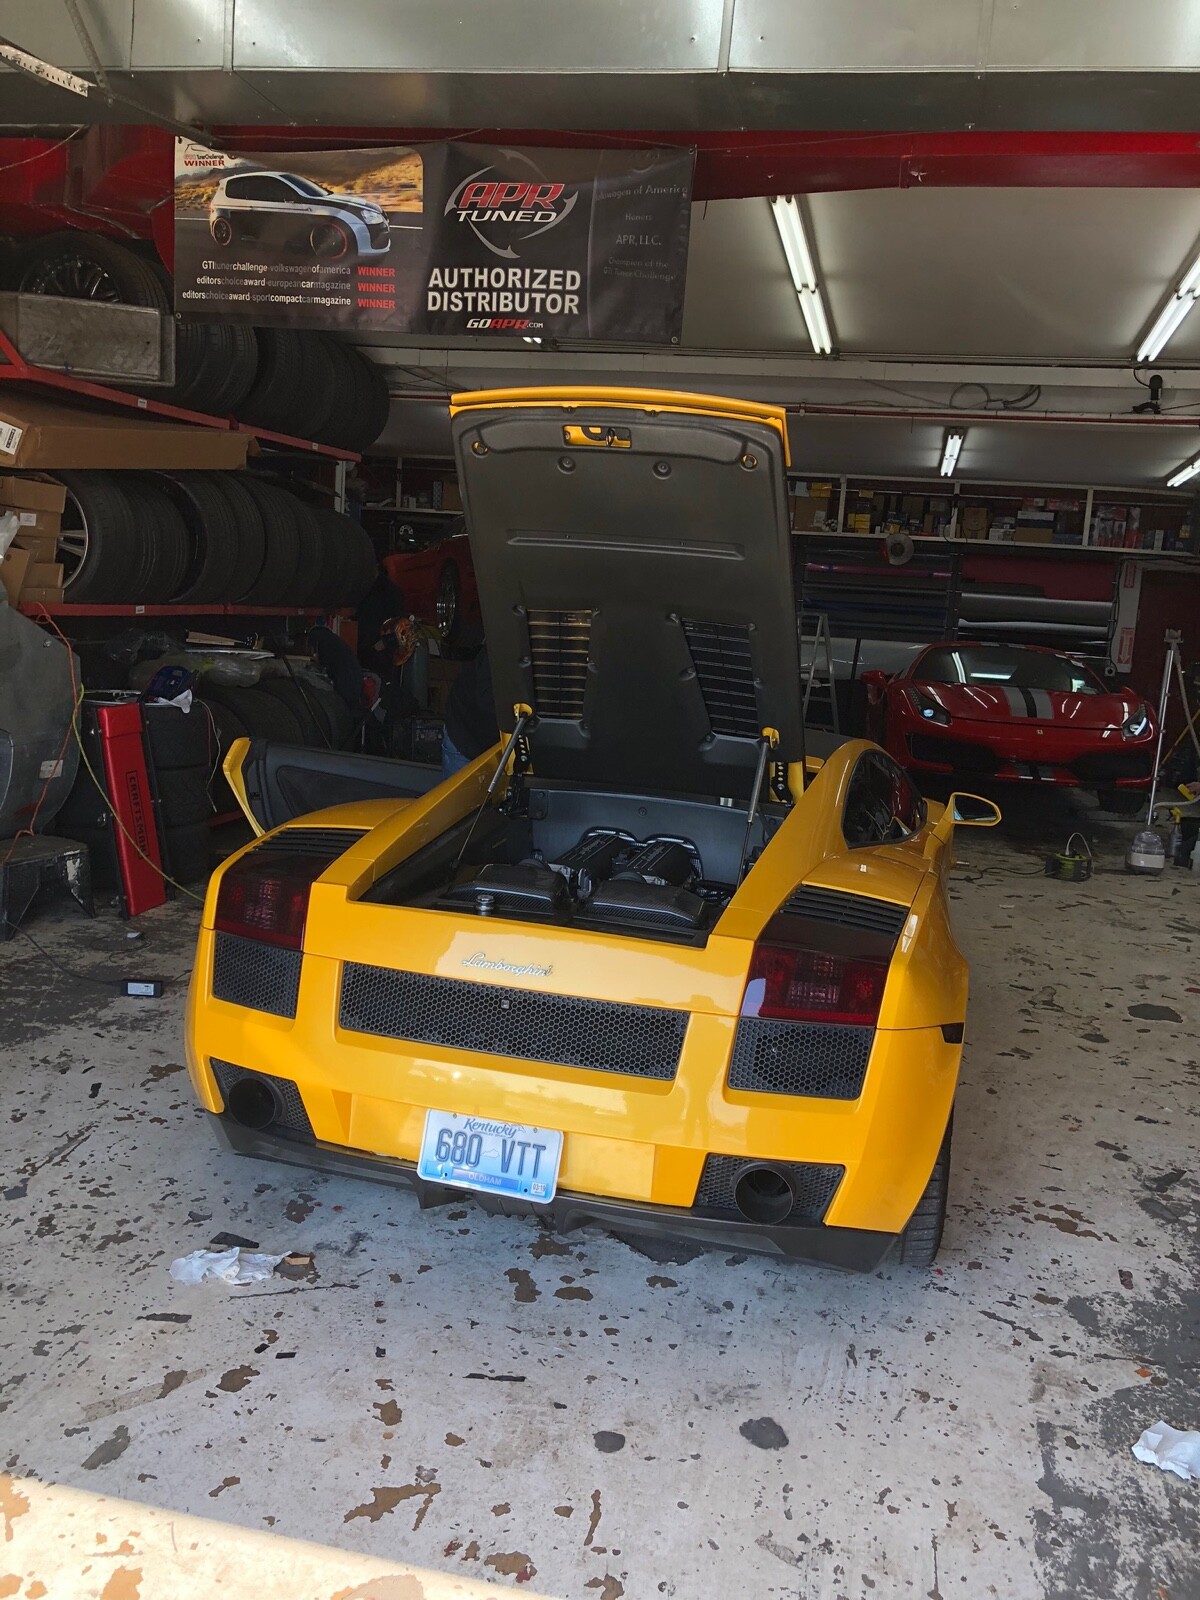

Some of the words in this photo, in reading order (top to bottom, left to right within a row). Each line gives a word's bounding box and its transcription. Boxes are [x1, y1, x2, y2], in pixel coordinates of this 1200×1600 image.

[184, 159, 225, 167] WINNER
[458, 182, 565, 209] APR
[456, 210, 557, 223] TUNED
[357, 266, 395, 277] WINNER
[428, 267, 581, 291] AUTHORIZED
[357, 282, 395, 293] WINNER
[357, 298, 395, 309] WINNER
[427, 291, 579, 315] DISTRIBUTOR
[129, 776, 147, 853] CRAFTSMAN
[462, 952, 553, 977] Lamborghini
[463, 1118, 517, 1139] Kentucky
[435, 1128, 483, 1168] 680
[500, 1138, 547, 1179] VTT
[468, 1172, 502, 1186] OLDHAM
